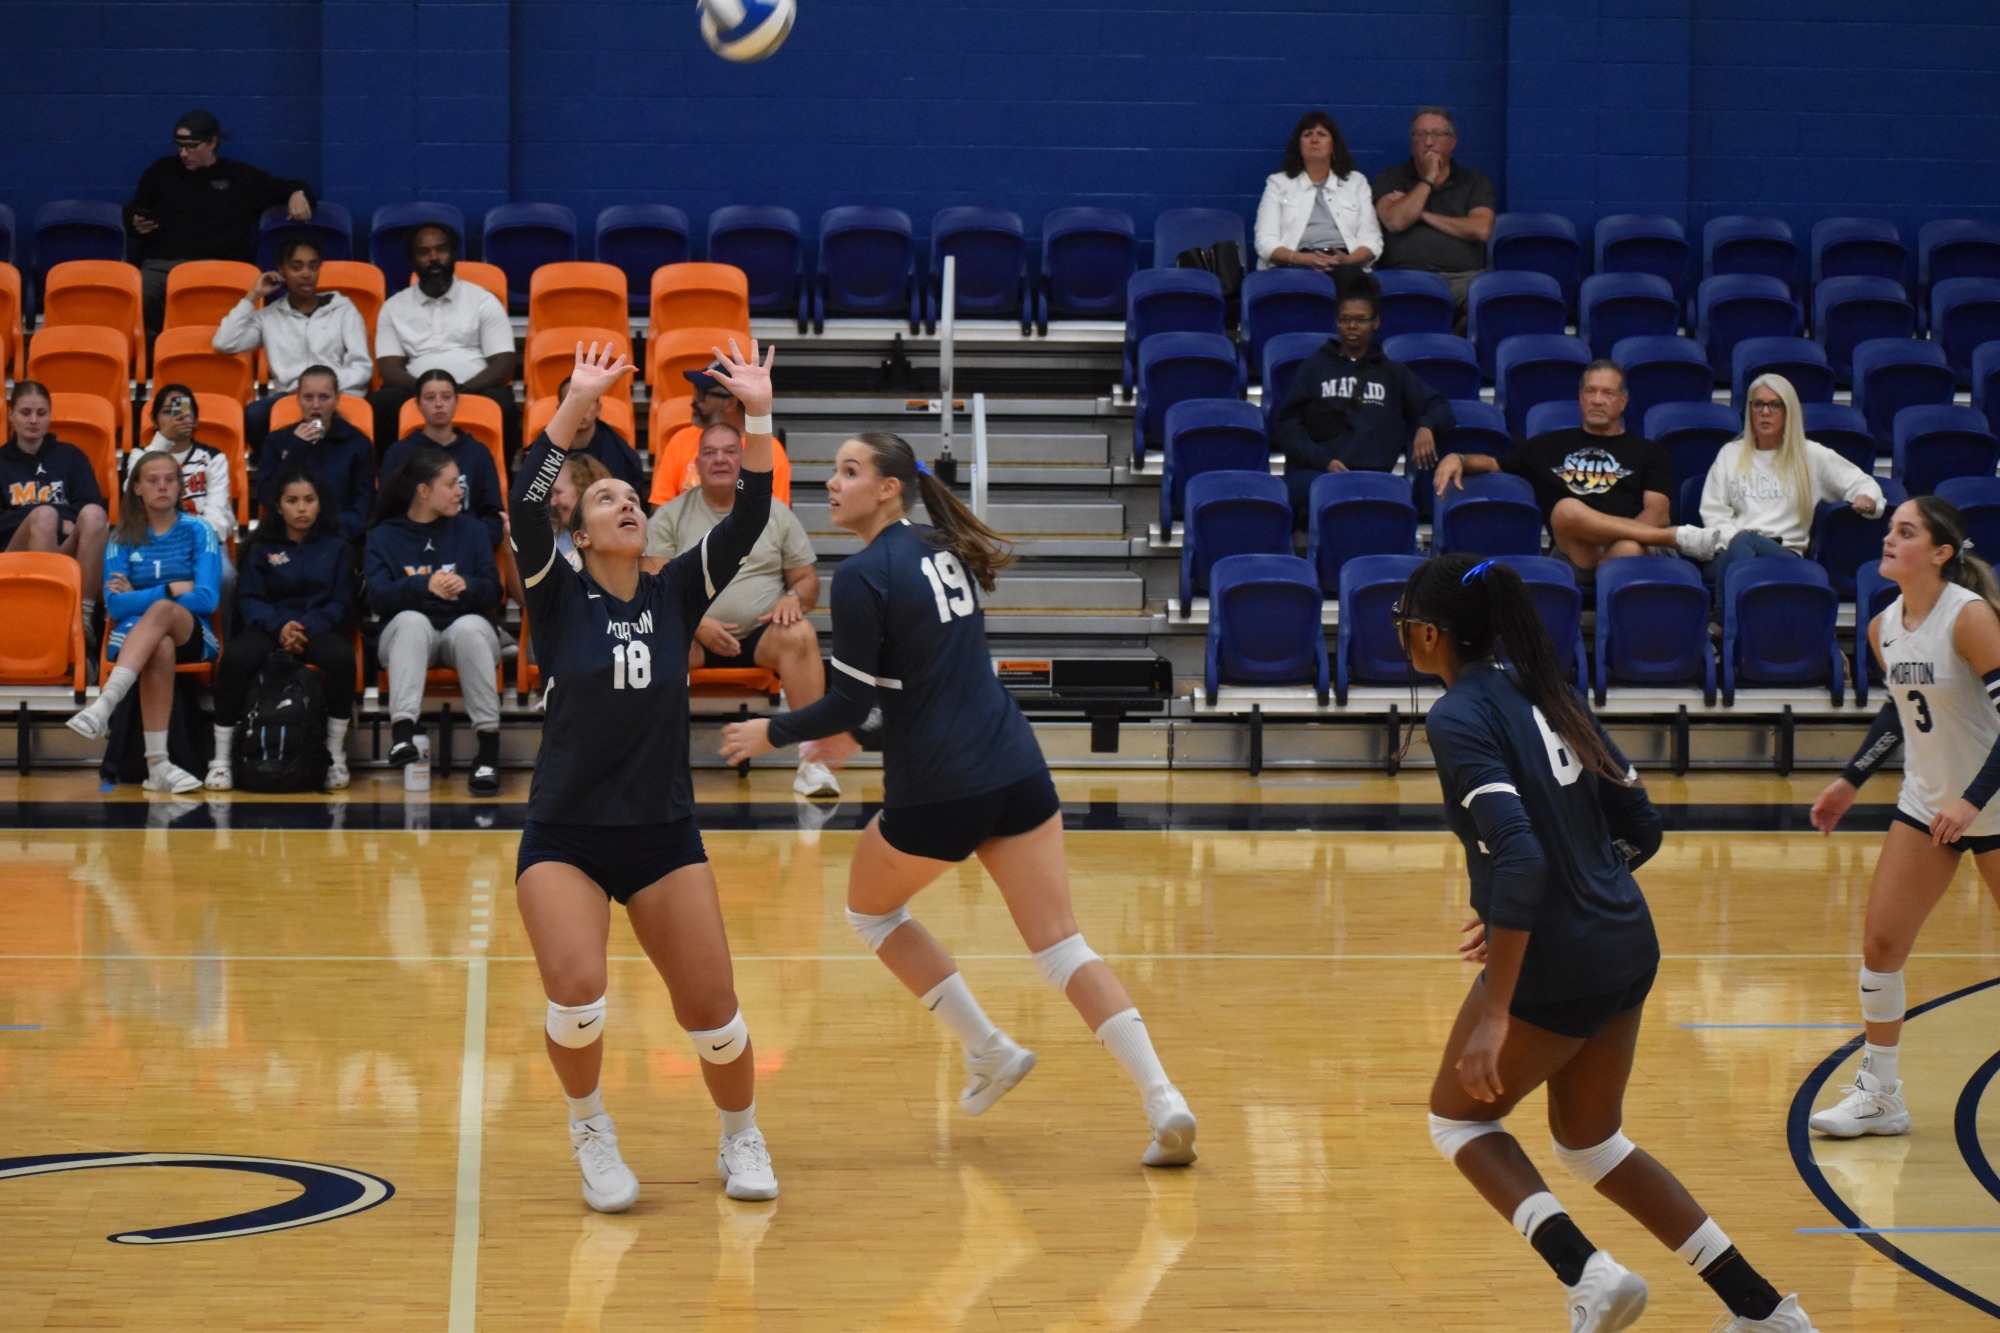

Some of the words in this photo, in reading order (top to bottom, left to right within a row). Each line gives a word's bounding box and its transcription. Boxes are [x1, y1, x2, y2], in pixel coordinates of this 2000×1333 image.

[1321, 376, 1385, 401] MAID
[522, 448, 565, 502] PANTHER
[1728, 472, 1795, 500] CHICA
[152, 560, 161, 579] 1
[921, 550, 975, 624] 19
[612, 640, 652, 690] 18
[1890, 661, 1935, 685] MORTON
[1907, 689, 1934, 733] 3
[1532, 704, 1584, 787] 6
